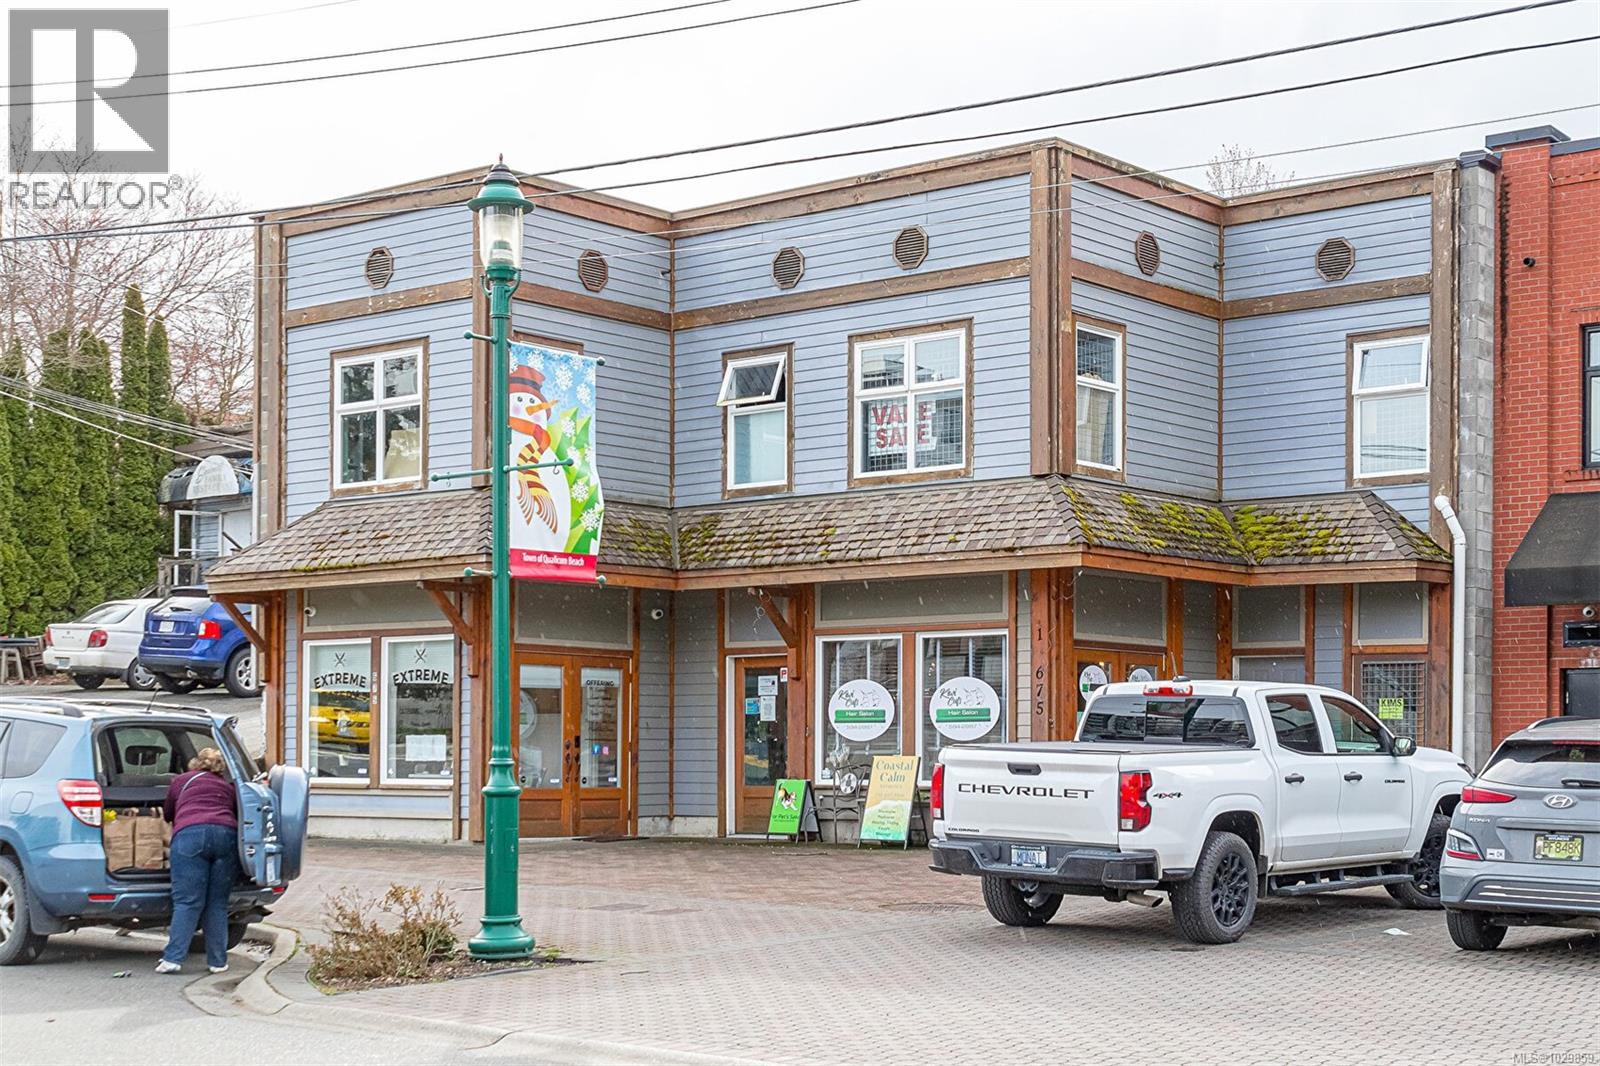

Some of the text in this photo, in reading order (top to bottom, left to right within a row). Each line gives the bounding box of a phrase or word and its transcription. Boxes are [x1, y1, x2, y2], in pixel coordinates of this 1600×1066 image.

[876, 424, 930, 448] SAE
[522, 552, 537, 562] Town
[568, 556, 585, 567] Beach
[314, 672, 367, 689] EXTREME
[392, 669, 449, 686] EXTREME
[1381, 699, 1402, 707] KIMS
[875, 760, 914, 771] Coastal
[879, 772, 906, 782] Calm
[958, 783, 1095, 799] CHEVROLET
